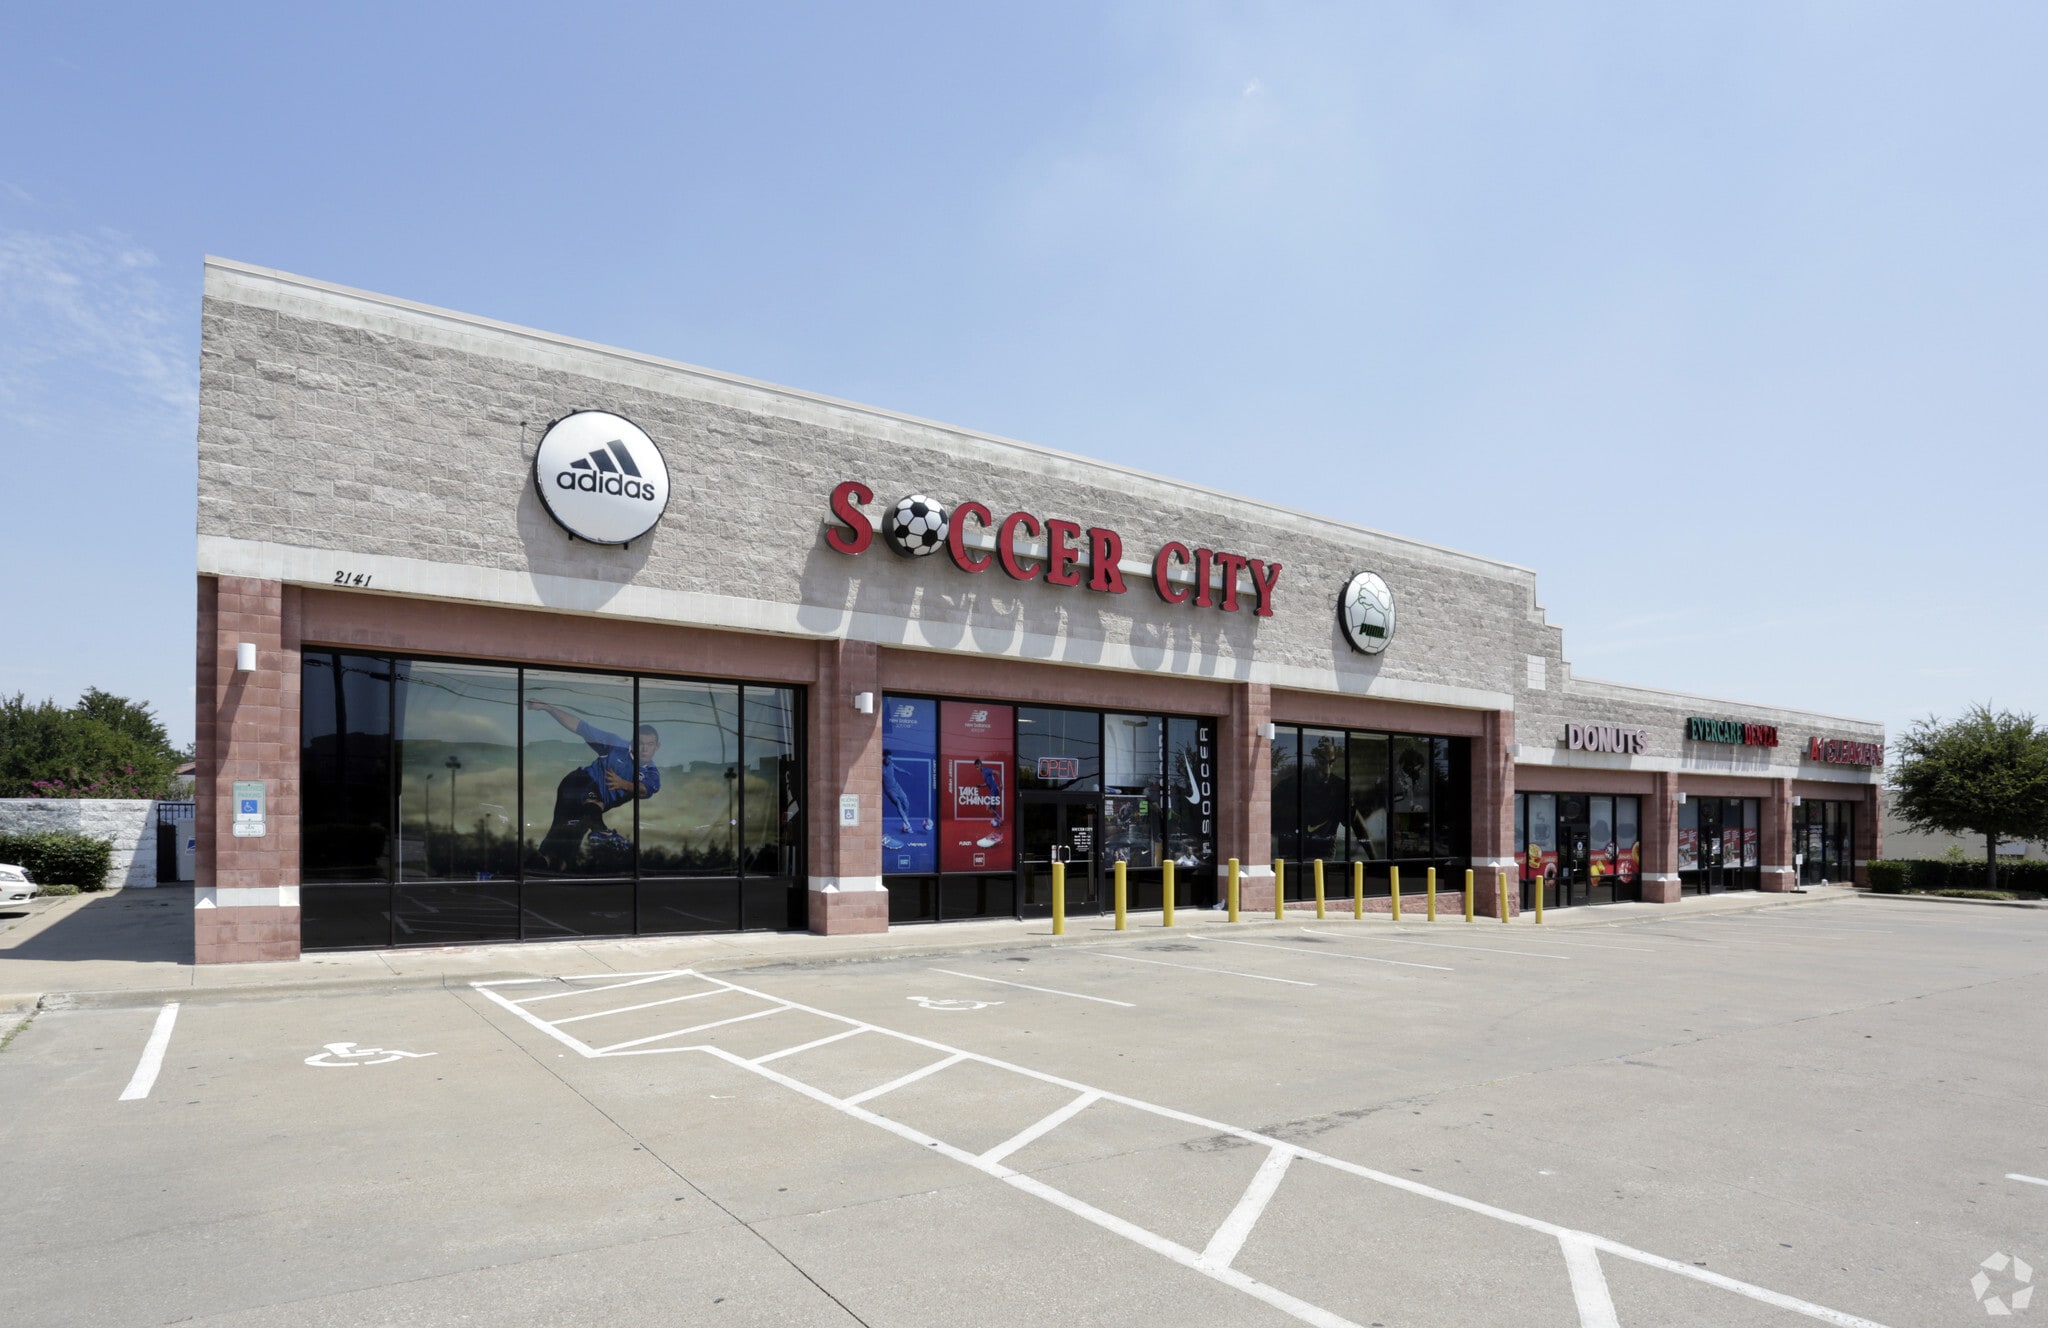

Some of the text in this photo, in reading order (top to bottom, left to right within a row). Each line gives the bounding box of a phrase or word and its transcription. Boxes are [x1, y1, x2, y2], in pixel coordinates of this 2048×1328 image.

[556, 470, 656, 501] adidas
[825, 481, 1283, 617] SOCCER CITY
[334, 570, 372, 587] 2141
[1359, 622, 1387, 639] PUMA
[1565, 723, 1649, 755] DONUTS
[1688, 717, 1778, 748] EVERCARE DENTAL
[1827, 739, 1885, 766] CLEANERS
[1039, 759, 1078, 778] OPEN
[1200, 727, 1211, 834] SOCCER
[959, 787, 979, 796] TAKE
[959, 796, 1001, 805] CHANCES
